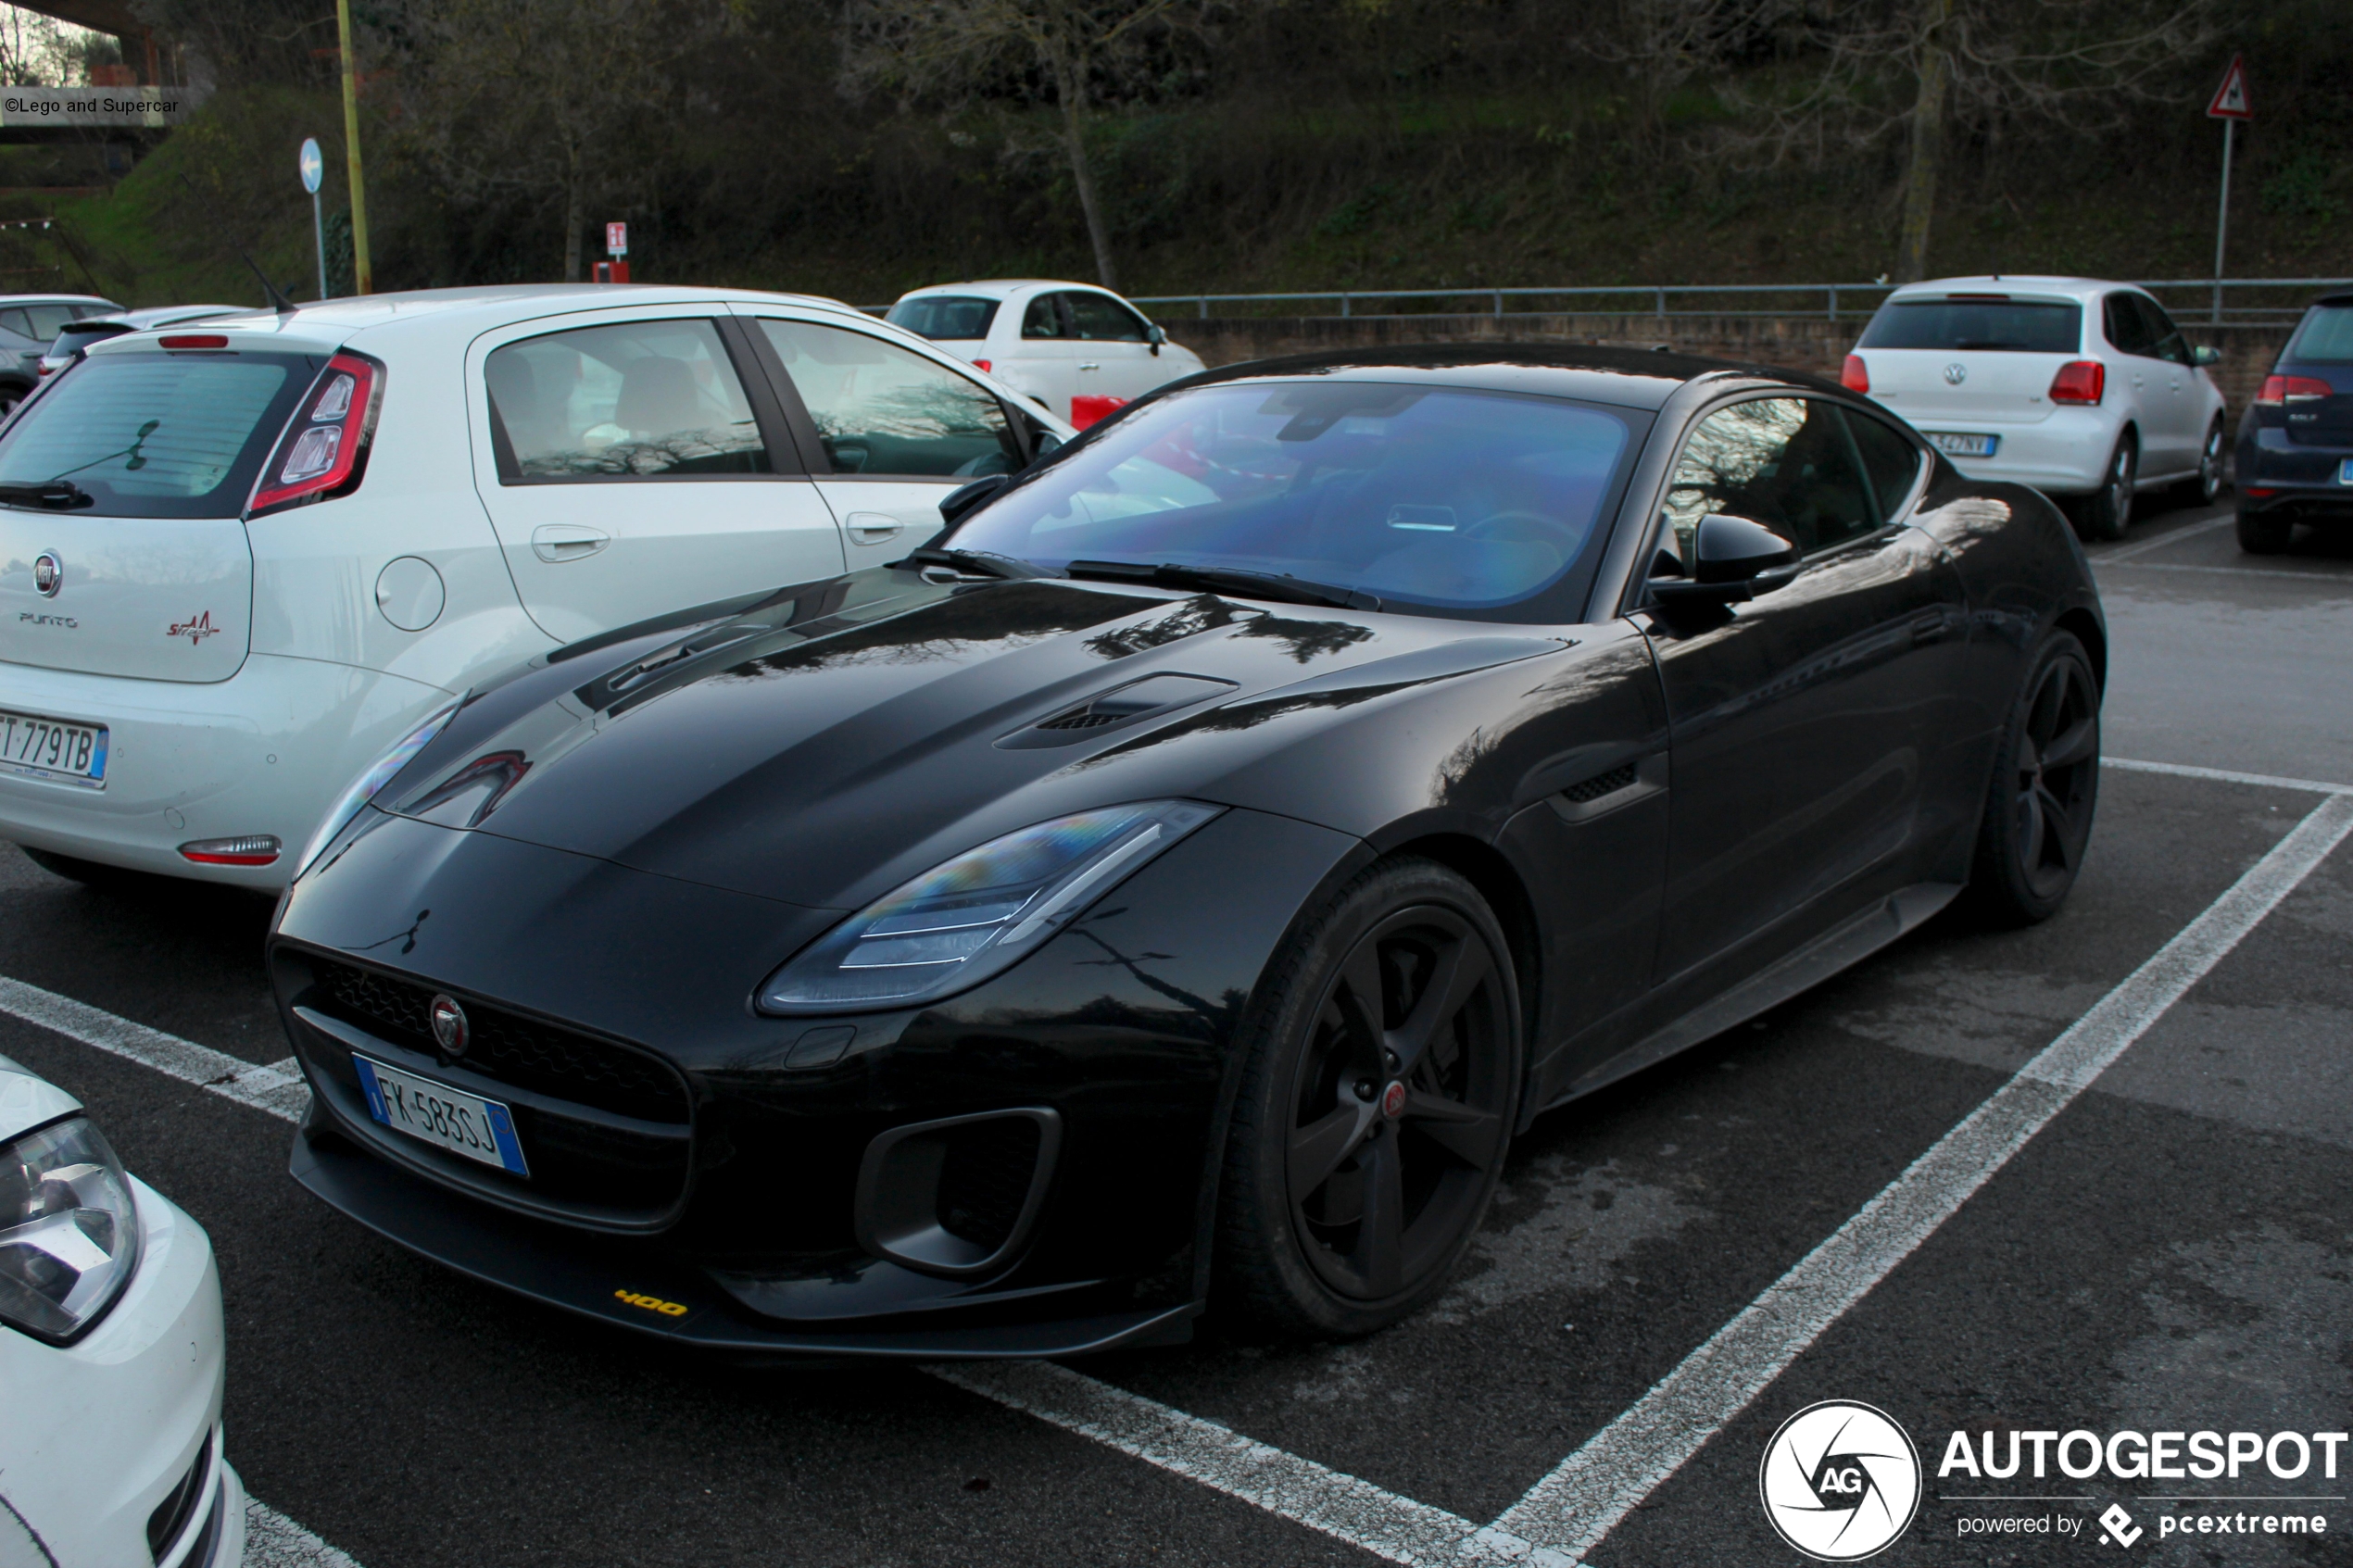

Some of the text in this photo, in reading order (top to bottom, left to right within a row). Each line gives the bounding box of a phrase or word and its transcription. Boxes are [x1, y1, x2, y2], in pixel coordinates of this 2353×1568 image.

[37, 565, 53, 583] FIAT
[19, 612, 78, 629] PUNTO
[614, 1289, 688, 1317] 400
